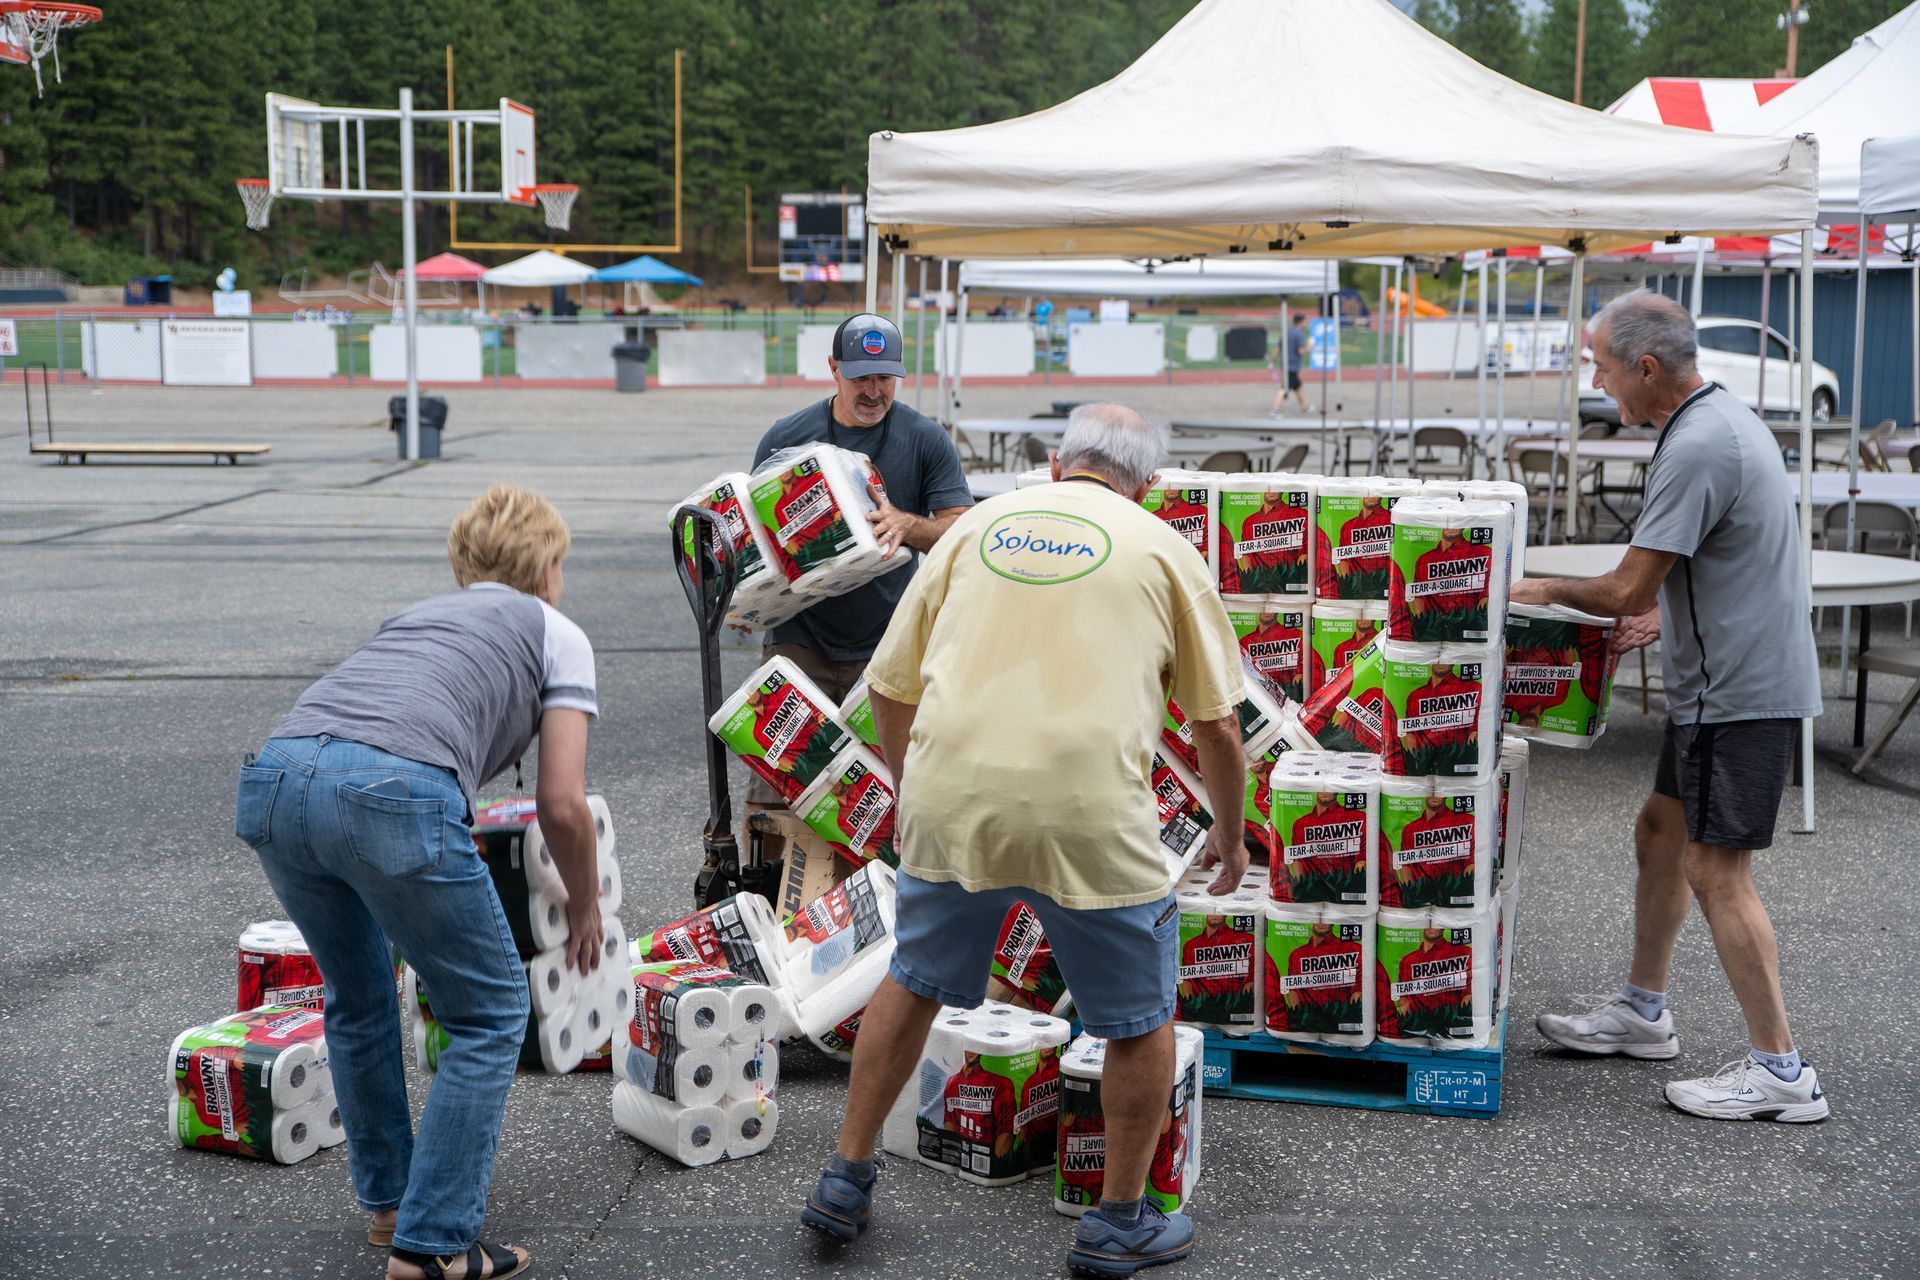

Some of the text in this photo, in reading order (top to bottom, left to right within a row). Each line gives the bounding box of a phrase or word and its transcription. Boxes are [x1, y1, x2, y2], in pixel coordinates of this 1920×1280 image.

[785, 482, 826, 520] BRAWNY
[1165, 515, 1205, 532] AWNY
[1254, 518, 1305, 538] BRAWNY
[989, 527, 1095, 558] Sojourn
[1238, 536, 1289, 552] TEAR-A-SQUARE
[1352, 526, 1391, 543] BRAW
[1336, 542, 1388, 557] TEAR-A-SQUARE
[1428, 557, 1488, 579] BRAWNY
[1410, 577, 1469, 595] TEAR-A-SQUARE
[1249, 639, 1300, 658] BRAWNY
[1505, 681, 1556, 695] BRAWN
[1420, 692, 1478, 714] BRAWNY
[764, 691, 802, 739] BRAWNY
[1402, 713, 1460, 729] TEAR-A-SQUARE
[768, 714, 802, 761] TEAR-A-SQUARE
[848, 781, 882, 829] BRAWNY
[852, 804, 883, 849] TEAR-A-SQUARE
[1305, 821, 1362, 842] BRAWNY
[1415, 825, 1471, 847] BRAWNY
[1288, 841, 1345, 857] TEAR-A-SQUARE
[1398, 845, 1455, 861] TEAR-A-SQUARE
[1002, 907, 1033, 959] BRAWNY
[664, 931, 687, 960] RAWNY
[1195, 944, 1251, 963] BRAWNY
[1009, 932, 1038, 981] TEAR-A-SQUARE
[1301, 953, 1358, 973] BRAWNY
[1179, 962, 1234, 977] TEAR-A-SQUARE
[1412, 956, 1469, 979] BRAWNY
[1284, 972, 1341, 987] TEAR-A-SQUARE
[1395, 977, 1452, 994] TEAR-A-SQUARE
[200, 1054, 218, 1115] BRAWNY
[960, 1084, 994, 1099] BRAWNY
[1030, 1080, 1060, 1104] BRAW
[217, 1074, 232, 1137] TEAR-A-SQUARE
[1064, 1153, 1105, 1171] AWNY
